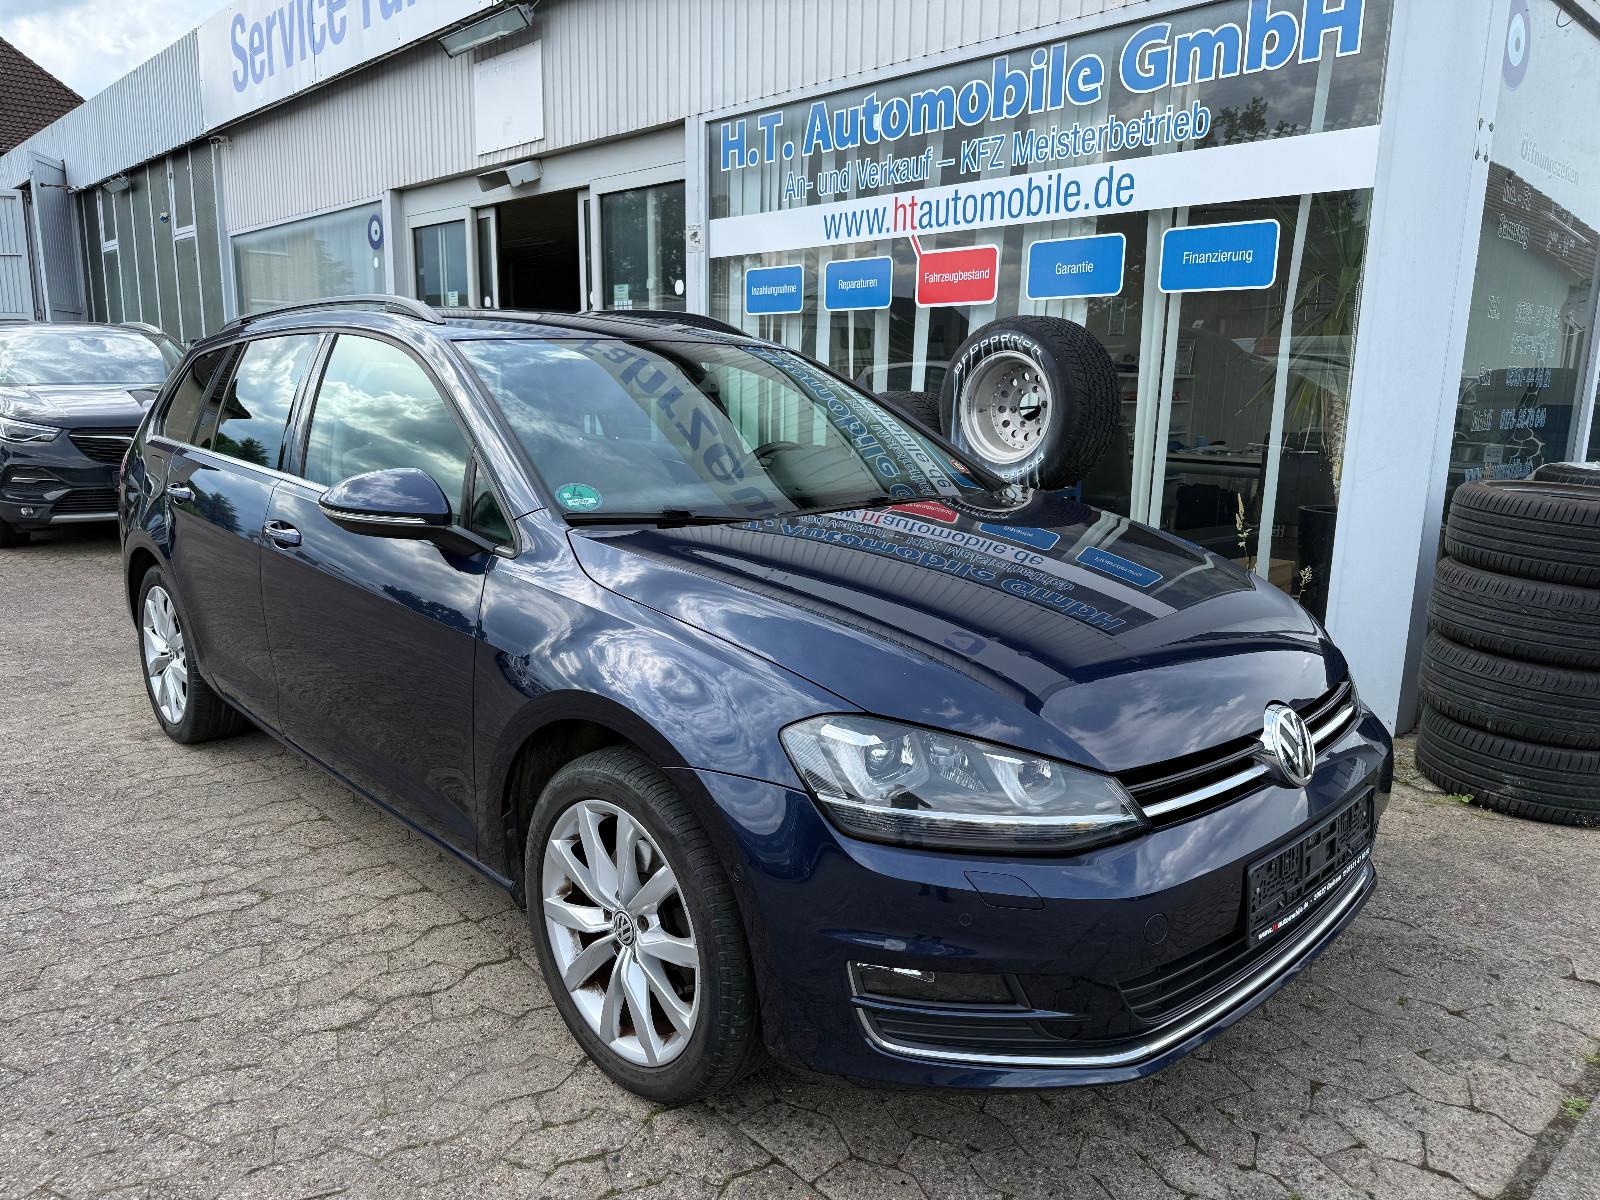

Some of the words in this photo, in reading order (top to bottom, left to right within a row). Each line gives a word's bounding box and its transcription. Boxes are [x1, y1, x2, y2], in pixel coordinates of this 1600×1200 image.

[231, 0, 347, 93] Service
[721, 111, 794, 171] H.T.
[802, 42, 1104, 157] Automobile
[1120, 0, 1364, 94] GmbH
[784, 172, 814, 201] An-
[817, 162, 851, 196] und
[856, 147, 934, 190] Verkauf
[961, 136, 1005, 174] KFZ
[1011, 101, 1211, 168] Meisterbetrieb
[1520, 131, 1579, 186] Öffnungszeiten
[823, 166, 1135, 239] www.htautomobile.de
[1055, 261, 1094, 275] Garantie
[1182, 249, 1254, 265] Finanzierung
[751, 284, 797, 297] Inzahlungnahme
[838, 278, 878, 292] Reparaturen
[924, 267, 990, 284] Fahrzeugbestand
